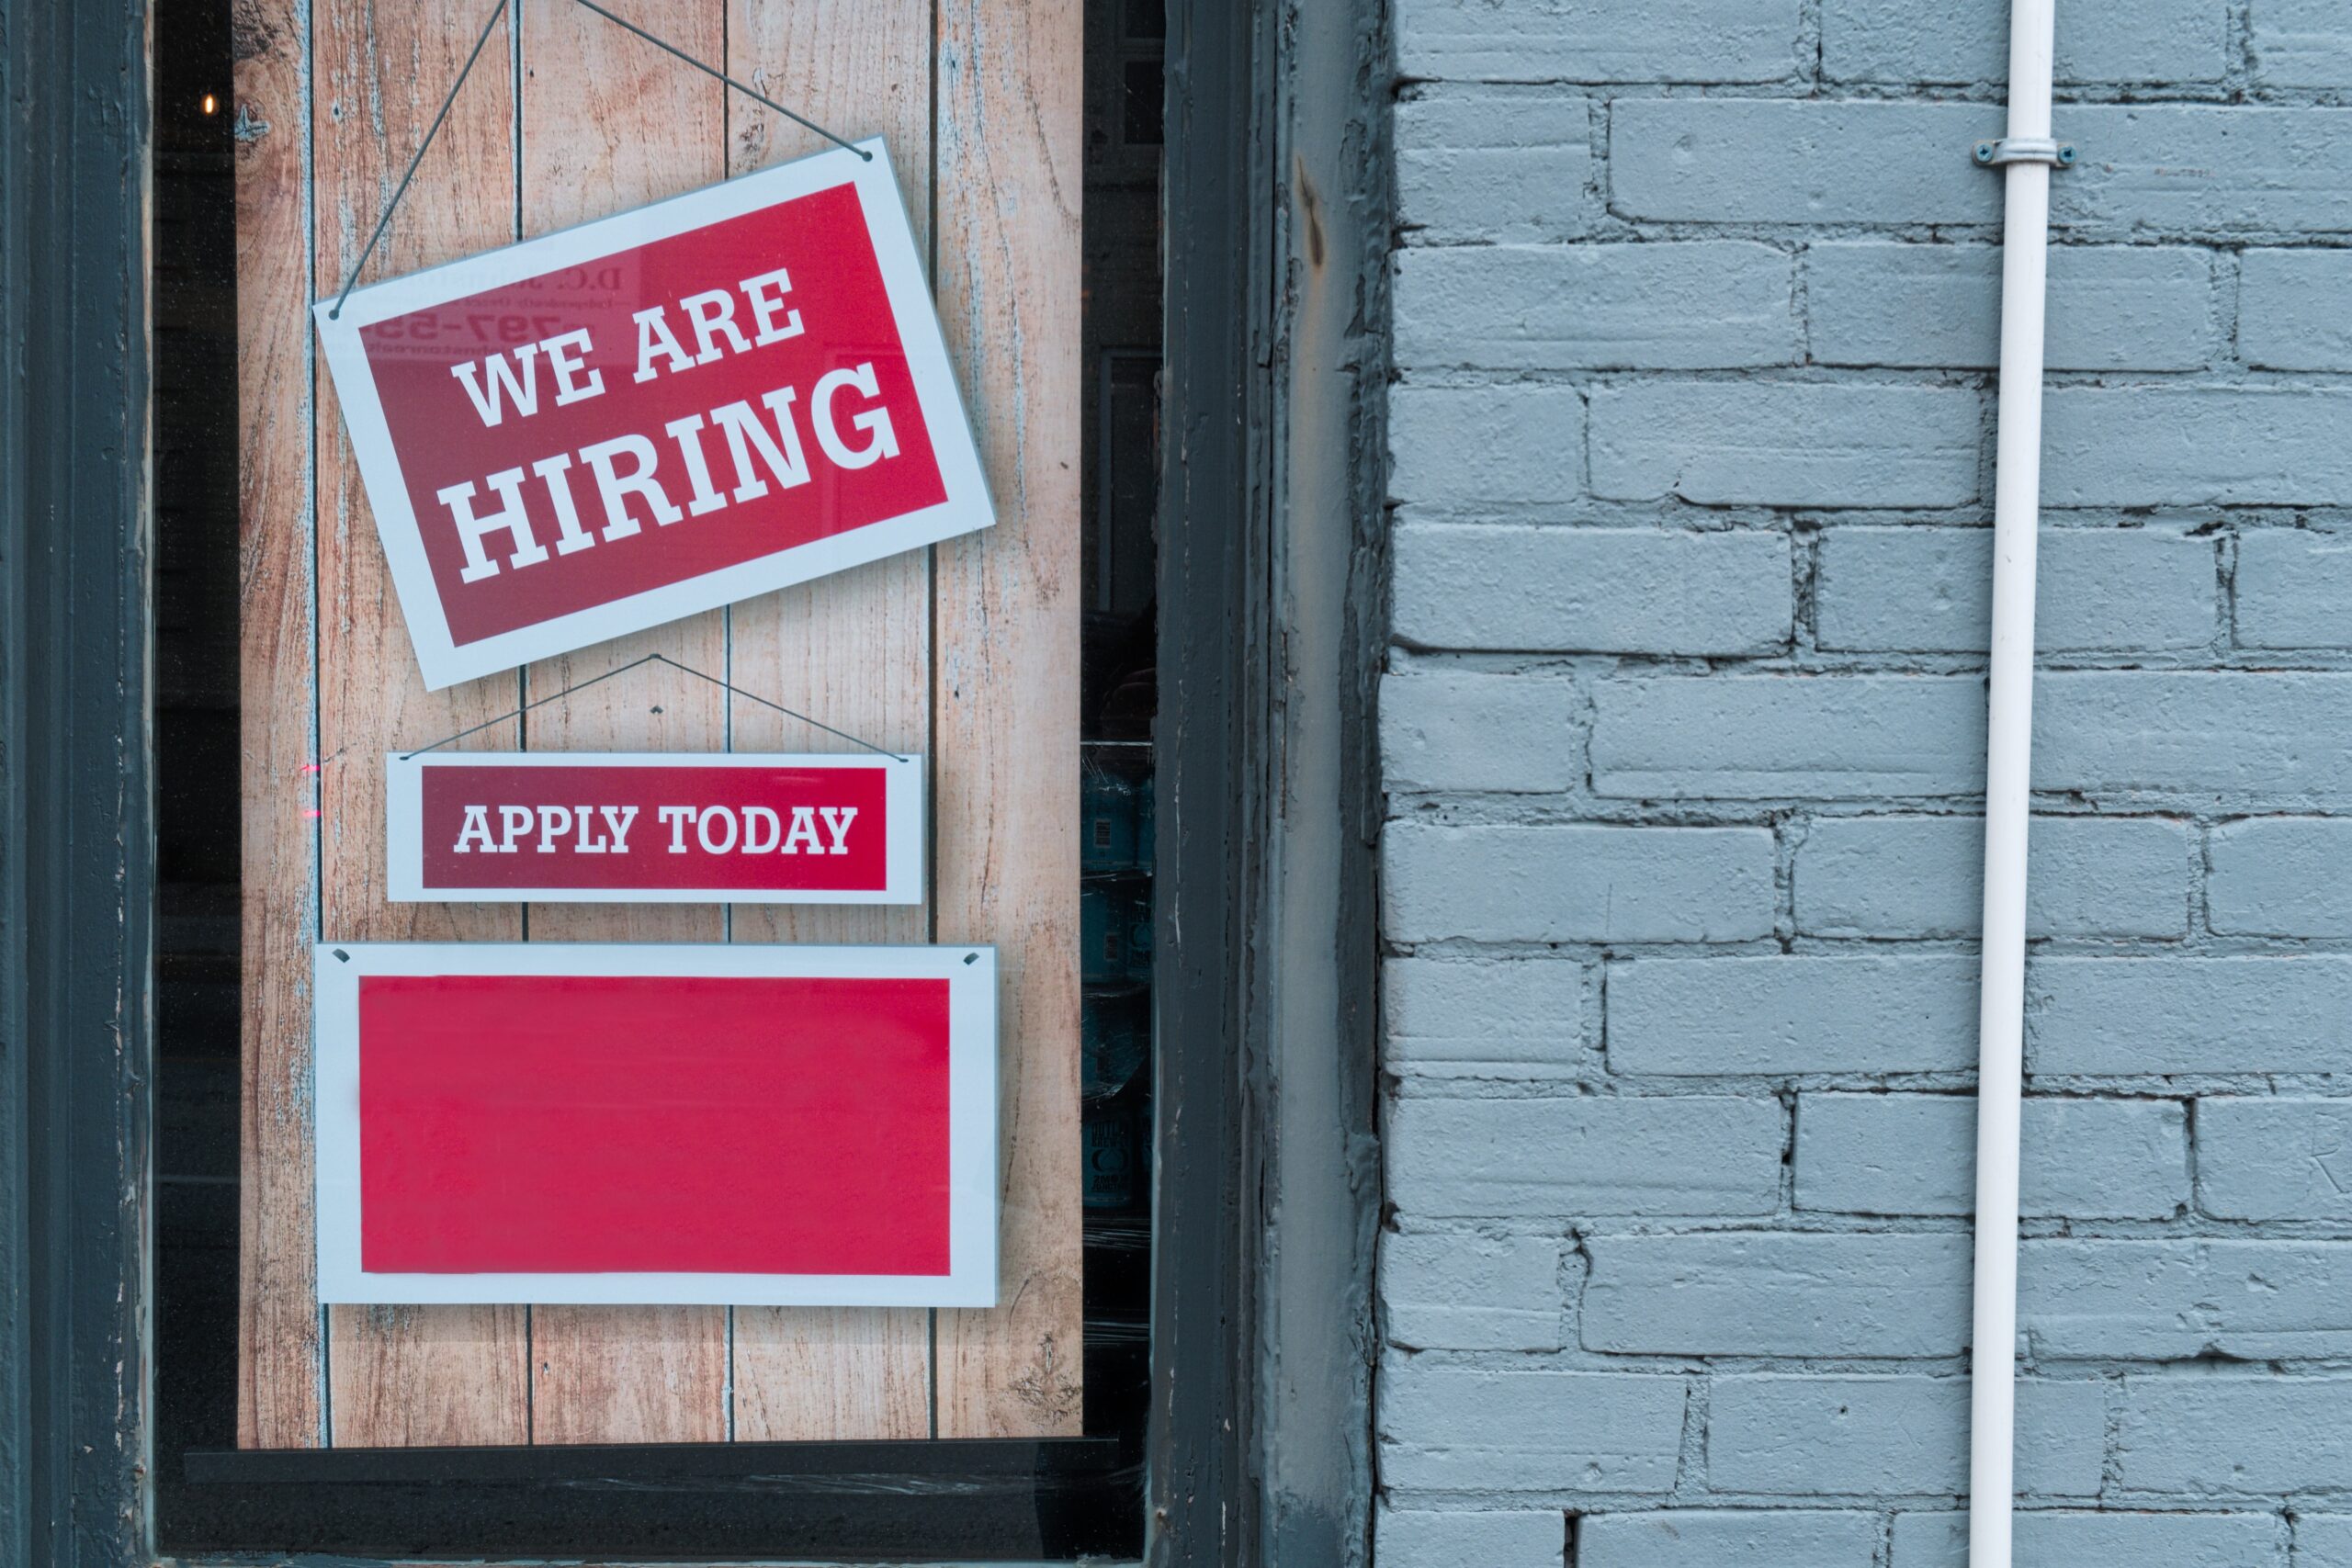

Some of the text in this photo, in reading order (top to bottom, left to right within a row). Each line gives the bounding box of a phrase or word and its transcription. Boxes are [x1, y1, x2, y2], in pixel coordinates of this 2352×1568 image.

[451, 268, 804, 427] WE ARE
[436, 363, 899, 583] HIRING
[454, 806, 857, 854] APPLY TODAY
